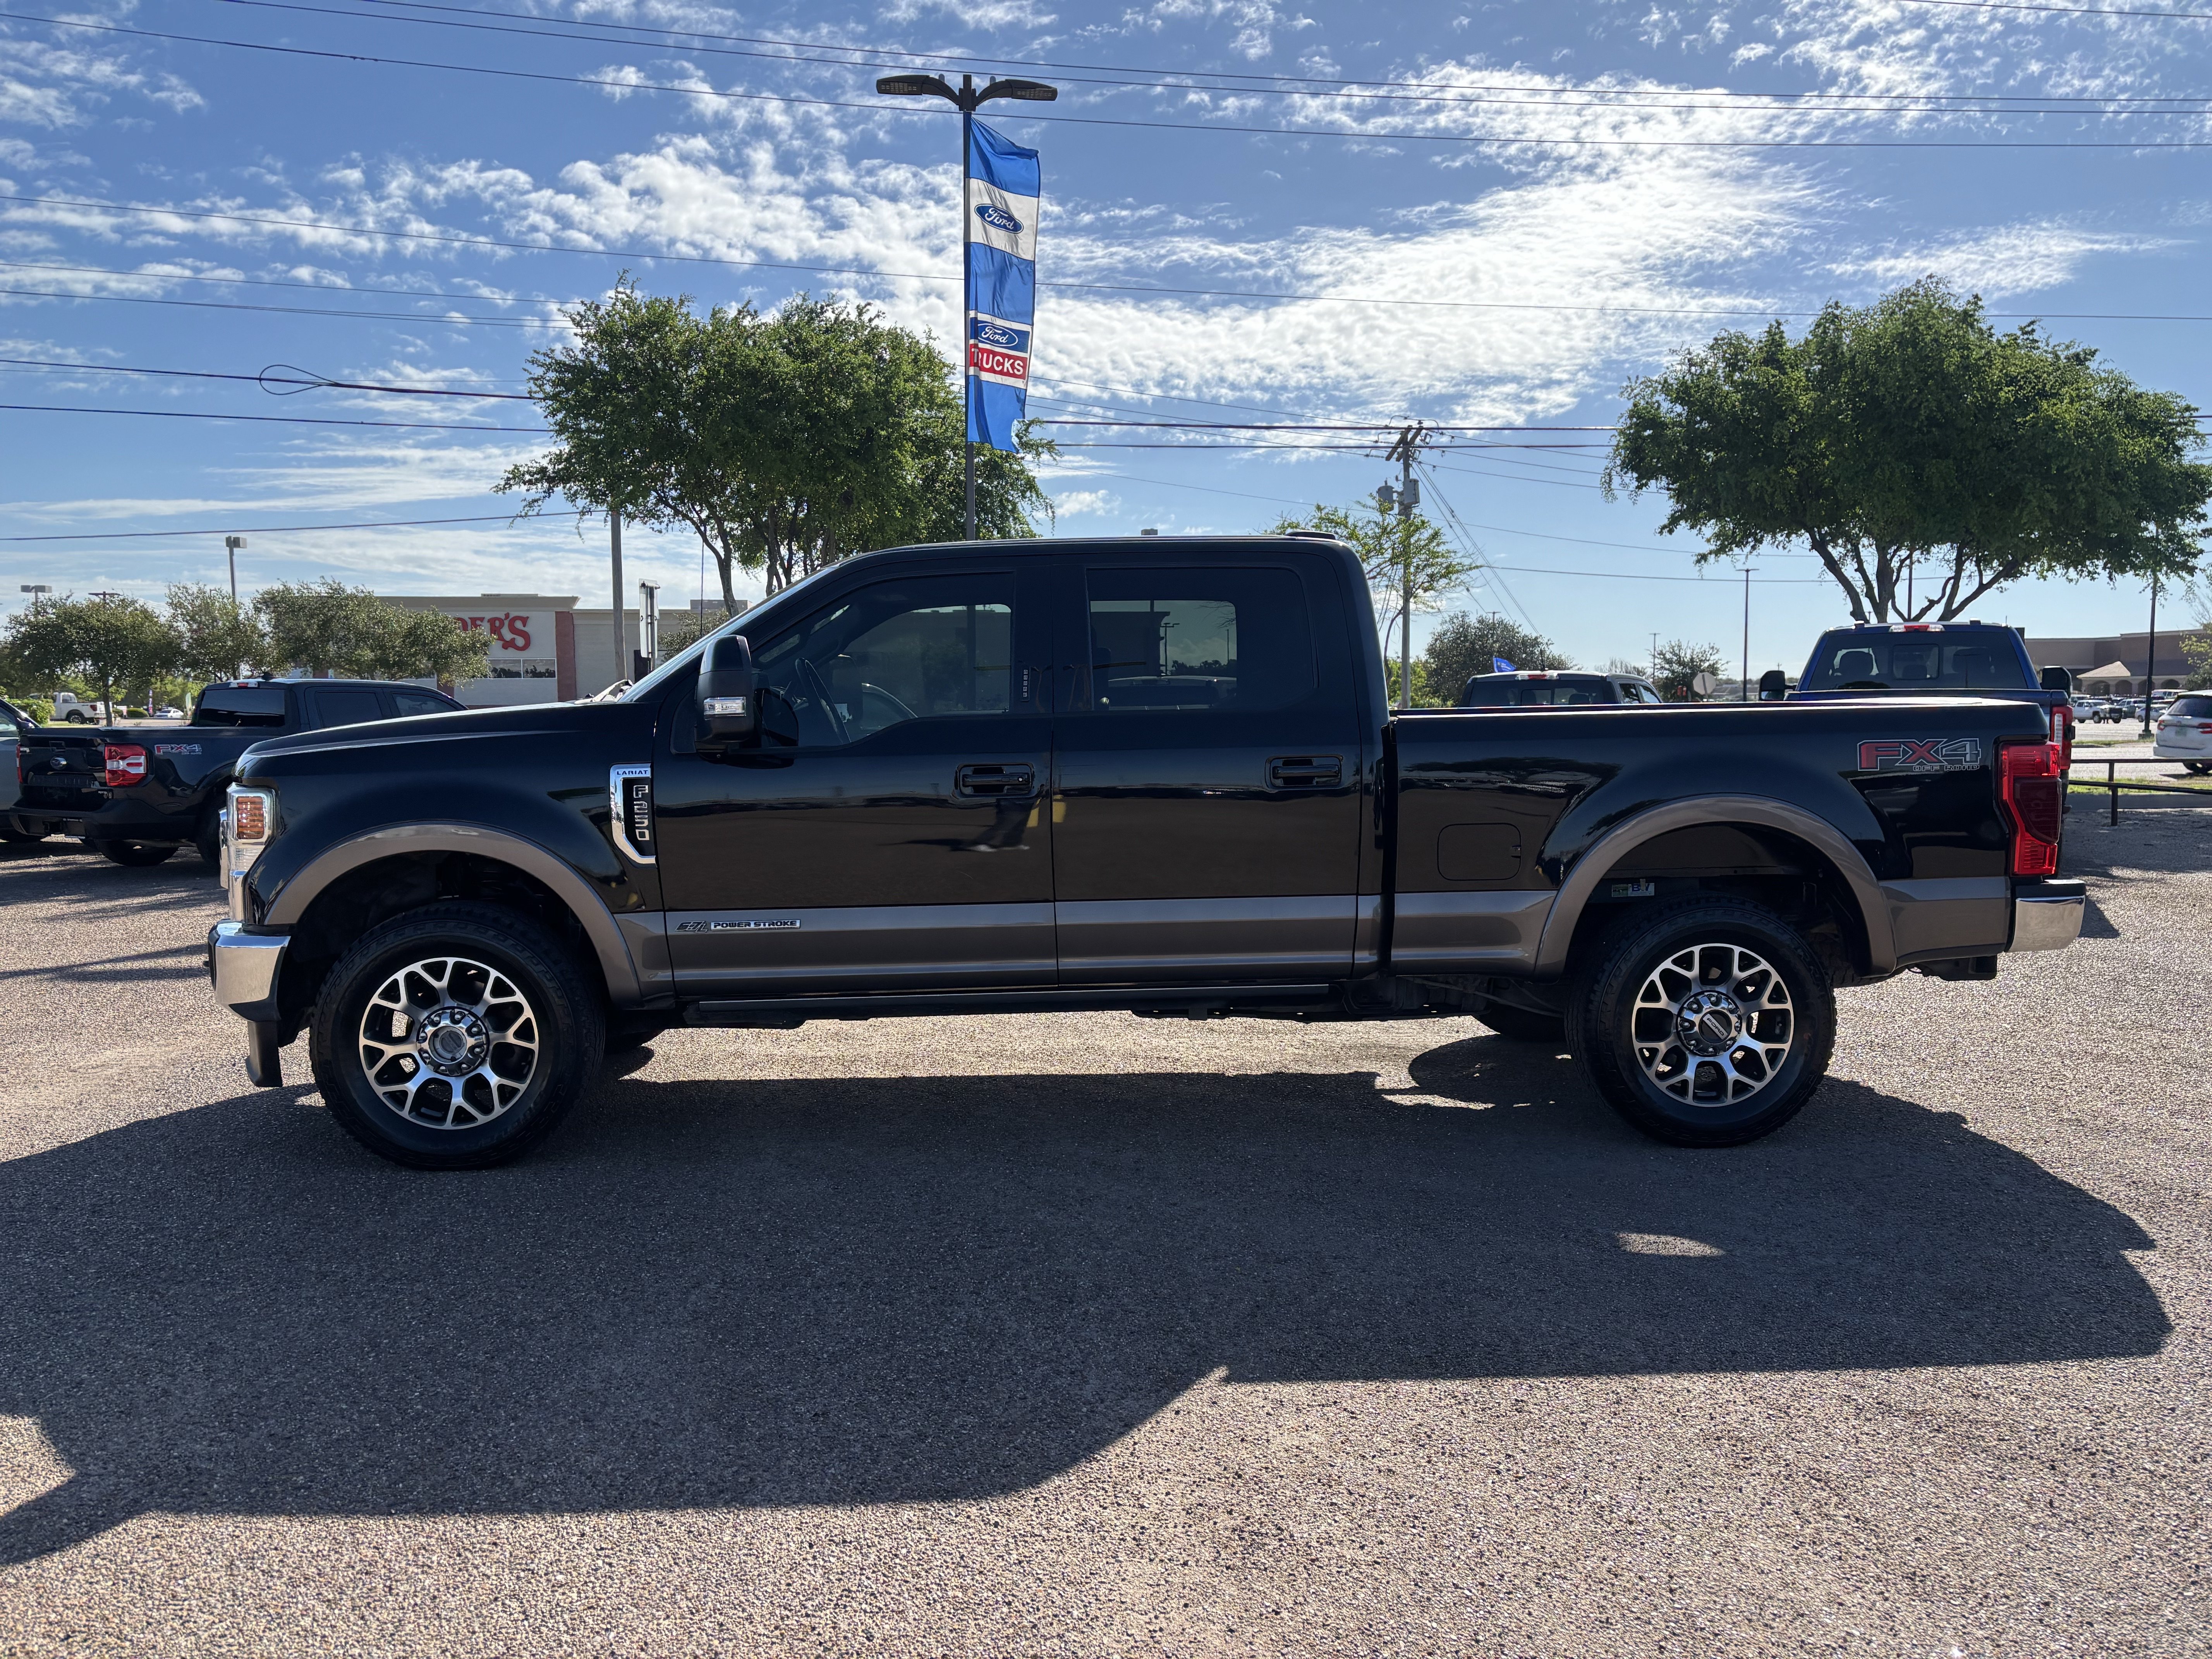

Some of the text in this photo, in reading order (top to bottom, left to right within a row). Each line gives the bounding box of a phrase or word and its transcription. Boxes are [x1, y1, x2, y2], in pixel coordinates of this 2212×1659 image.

[984, 208, 1014, 230] Ford
[981, 326, 1009, 343] Ford
[154, 744, 202, 755] FX4
[1857, 738, 1981, 771] FX4
[1707, 1018, 1724, 1036] FORD
